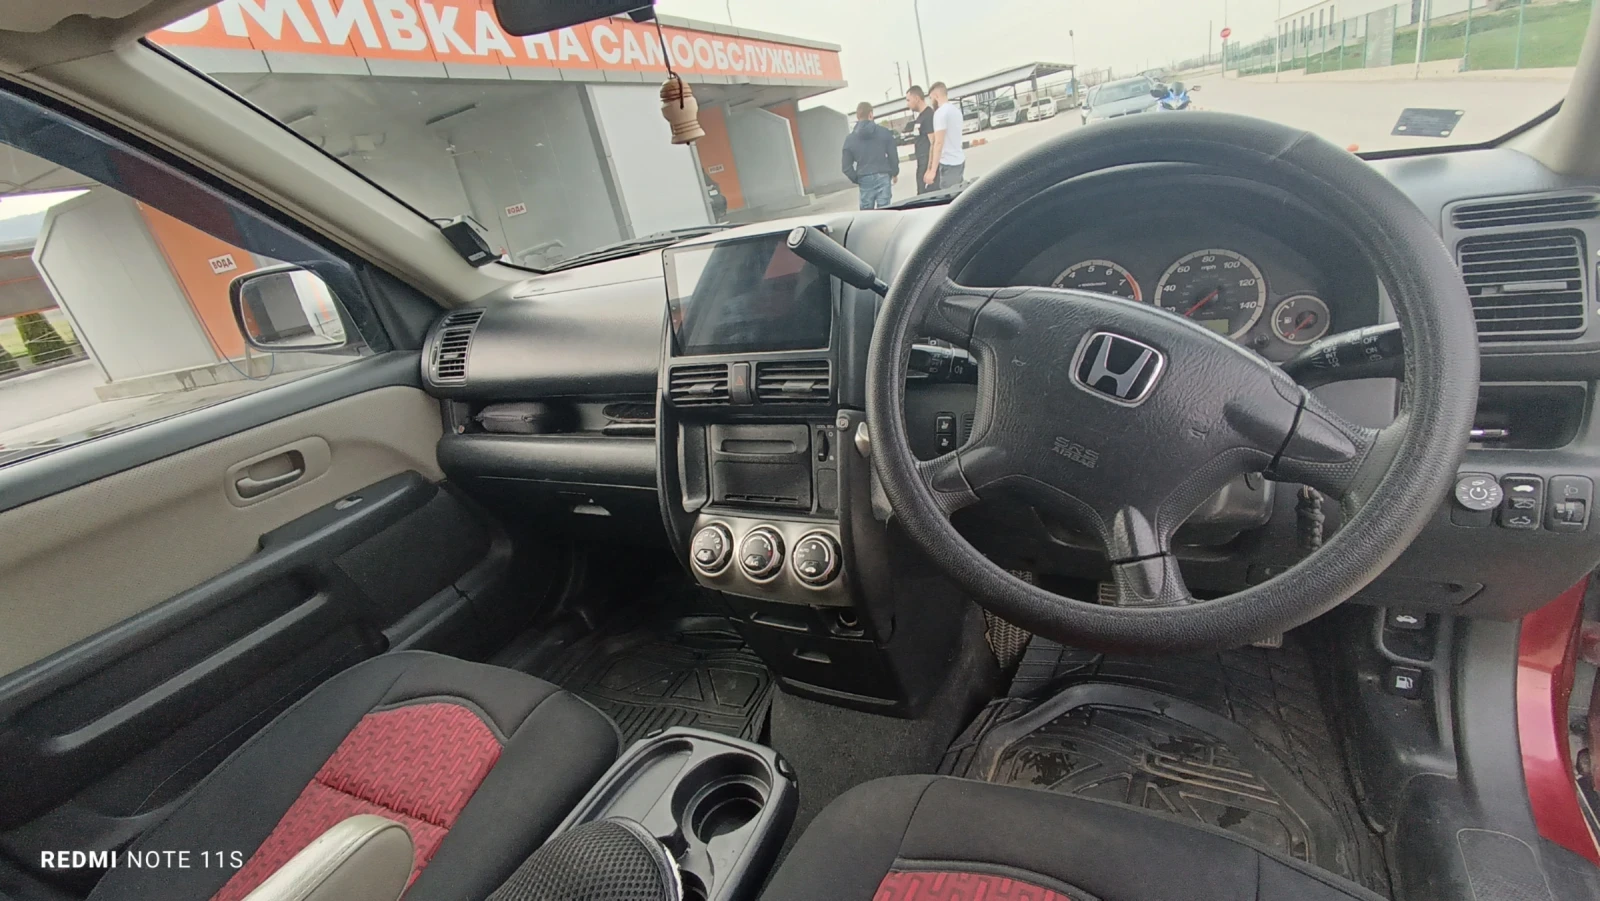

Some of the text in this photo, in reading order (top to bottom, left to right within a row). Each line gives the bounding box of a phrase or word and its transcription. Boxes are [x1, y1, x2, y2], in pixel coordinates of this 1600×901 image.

[521, 27, 590, 62] НА
[591, 24, 823, 76] САМООБСЛУЖВАНЕ
[211, 257, 233, 270] ВОДА
[1224, 261, 1240, 269] 100
[1088, 265, 1095, 273] 5
[1105, 268, 1113, 276] 6
[1177, 265, 1190, 273] 60
[1068, 271, 1076, 279] 4
[1239, 279, 1255, 287] 120
[1240, 301, 1257, 309] 140
[1363, 335, 1378, 344] OFF
